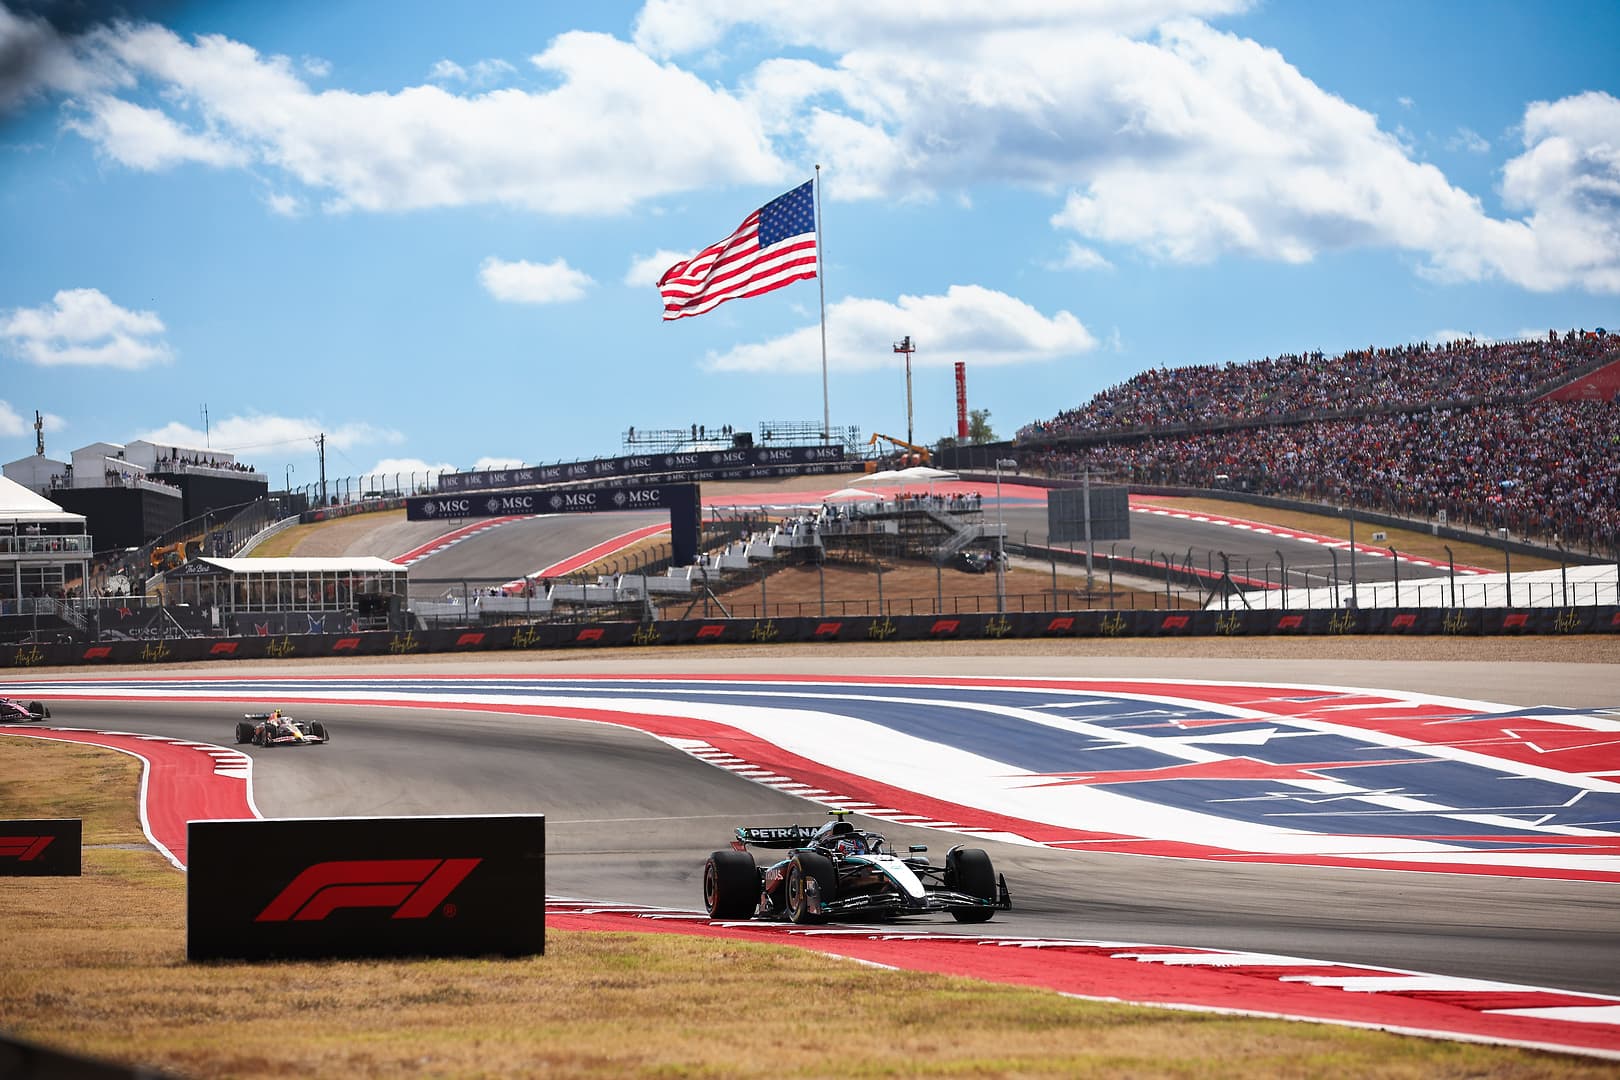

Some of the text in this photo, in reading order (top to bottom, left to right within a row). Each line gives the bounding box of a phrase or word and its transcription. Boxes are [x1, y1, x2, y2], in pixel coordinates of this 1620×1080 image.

[723, 452, 745, 461] MSC
[770, 450, 792, 458] MSC
[816, 448, 838, 457] MSC
[631, 458, 651, 466] MSC
[676, 455, 698, 464] MSC
[574, 465, 588, 473] MSC
[601, 462, 615, 470] MSC
[520, 471, 533, 479] MSC
[547, 468, 560, 477] MSC
[447, 477, 458, 486] MSC
[471, 475, 482, 484] MSC
[494, 473, 506, 482] MSC
[566, 494, 596, 505] MSC
[630, 490, 660, 501] MSC
[439, 500, 470, 512] MSC
[502, 496, 533, 508] MSC
[254, 857, 483, 921] F1
